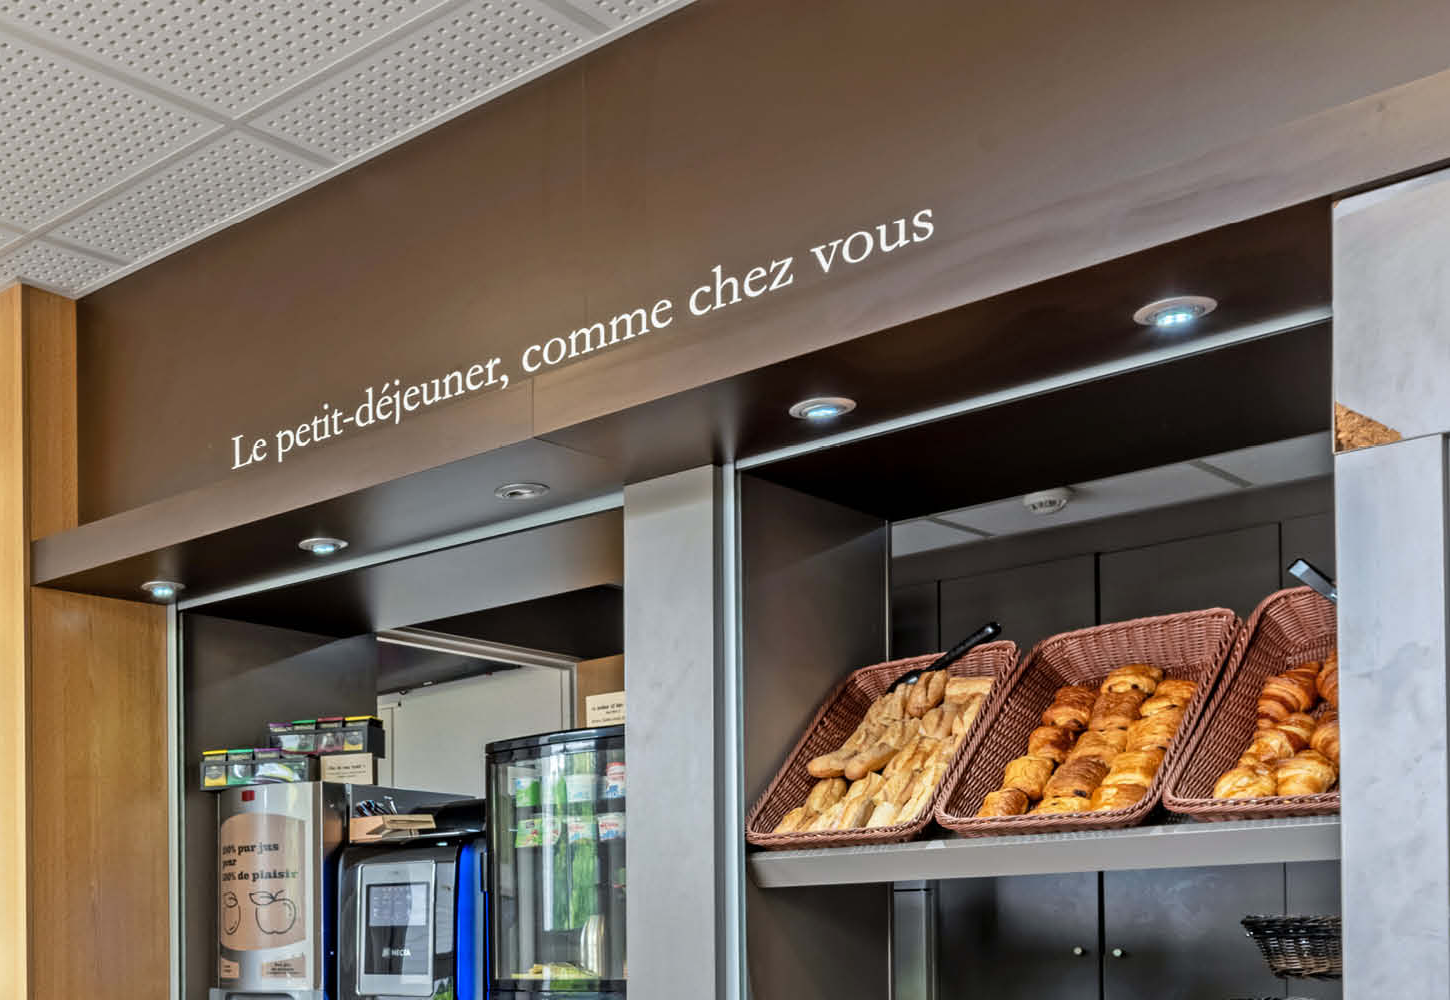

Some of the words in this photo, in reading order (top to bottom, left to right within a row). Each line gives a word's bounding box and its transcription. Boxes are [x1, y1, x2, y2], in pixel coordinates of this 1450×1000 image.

[230, 434, 267, 471] Le
[275, 356, 510, 463] petit-déjeuner,
[521, 299, 673, 373] comme
[688, 256, 795, 317] chez
[809, 208, 935, 274] vous
